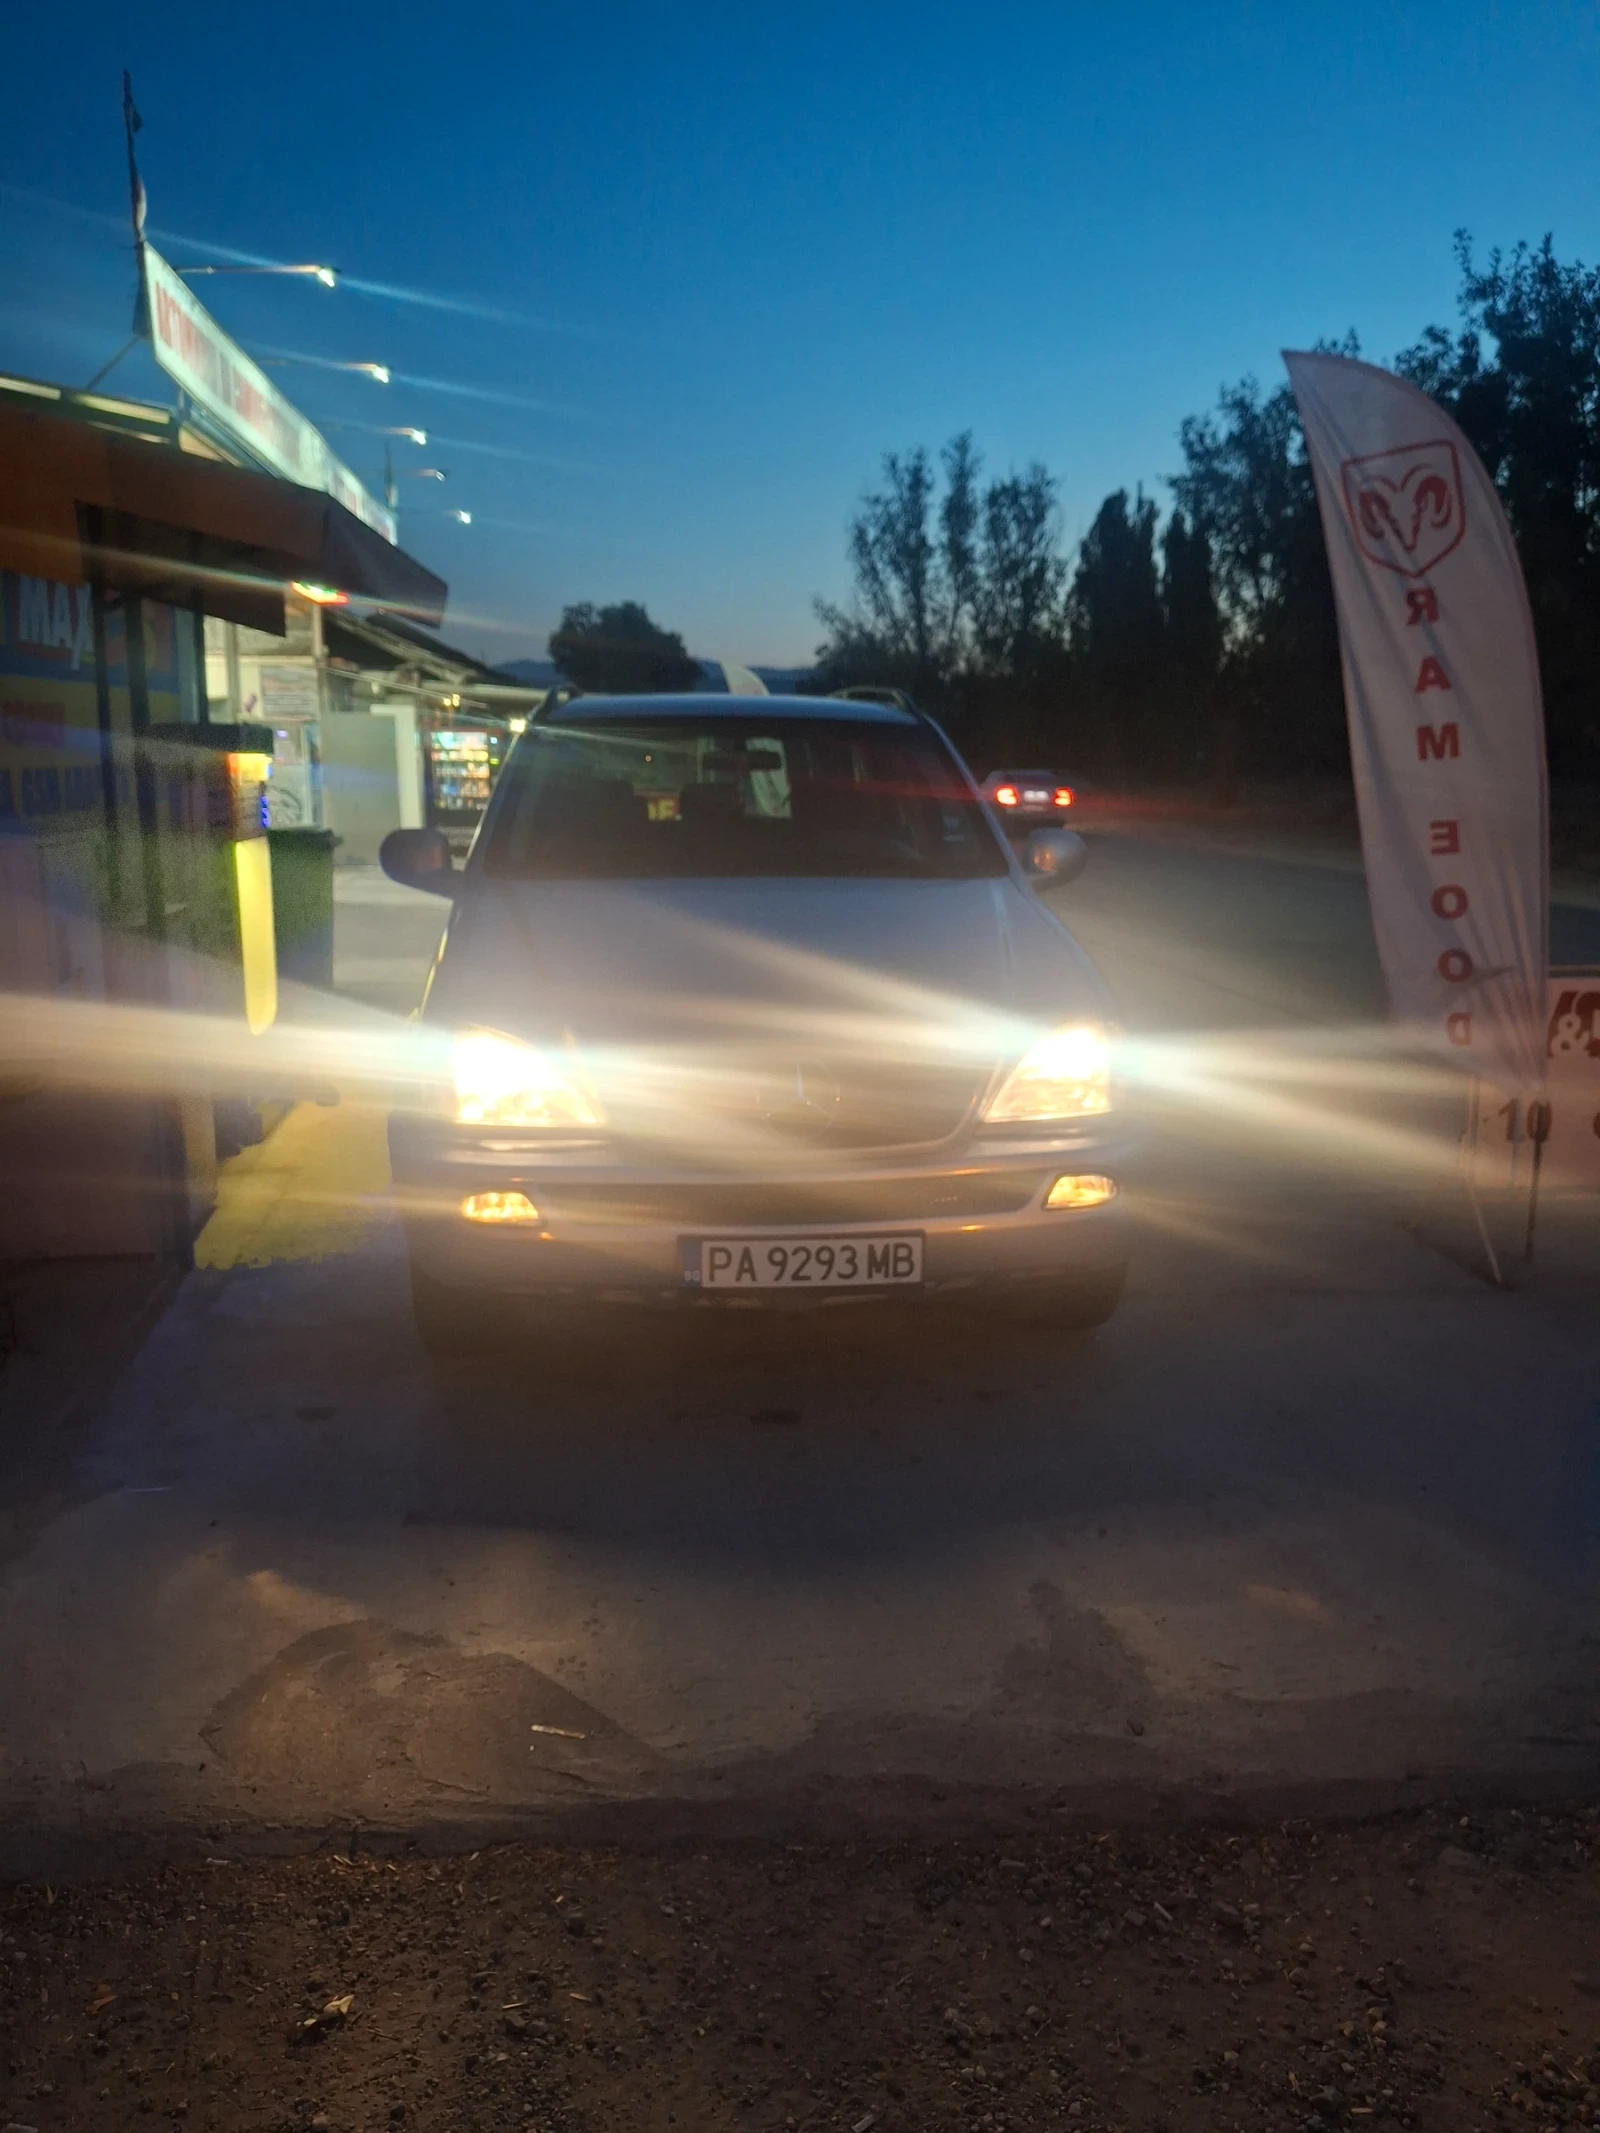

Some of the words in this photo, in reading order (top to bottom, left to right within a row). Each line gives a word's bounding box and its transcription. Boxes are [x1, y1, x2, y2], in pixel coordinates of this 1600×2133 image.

[707, 1246, 758, 1282] PA
[767, 1245, 859, 1282] 9293
[866, 1243, 916, 1280] MB
